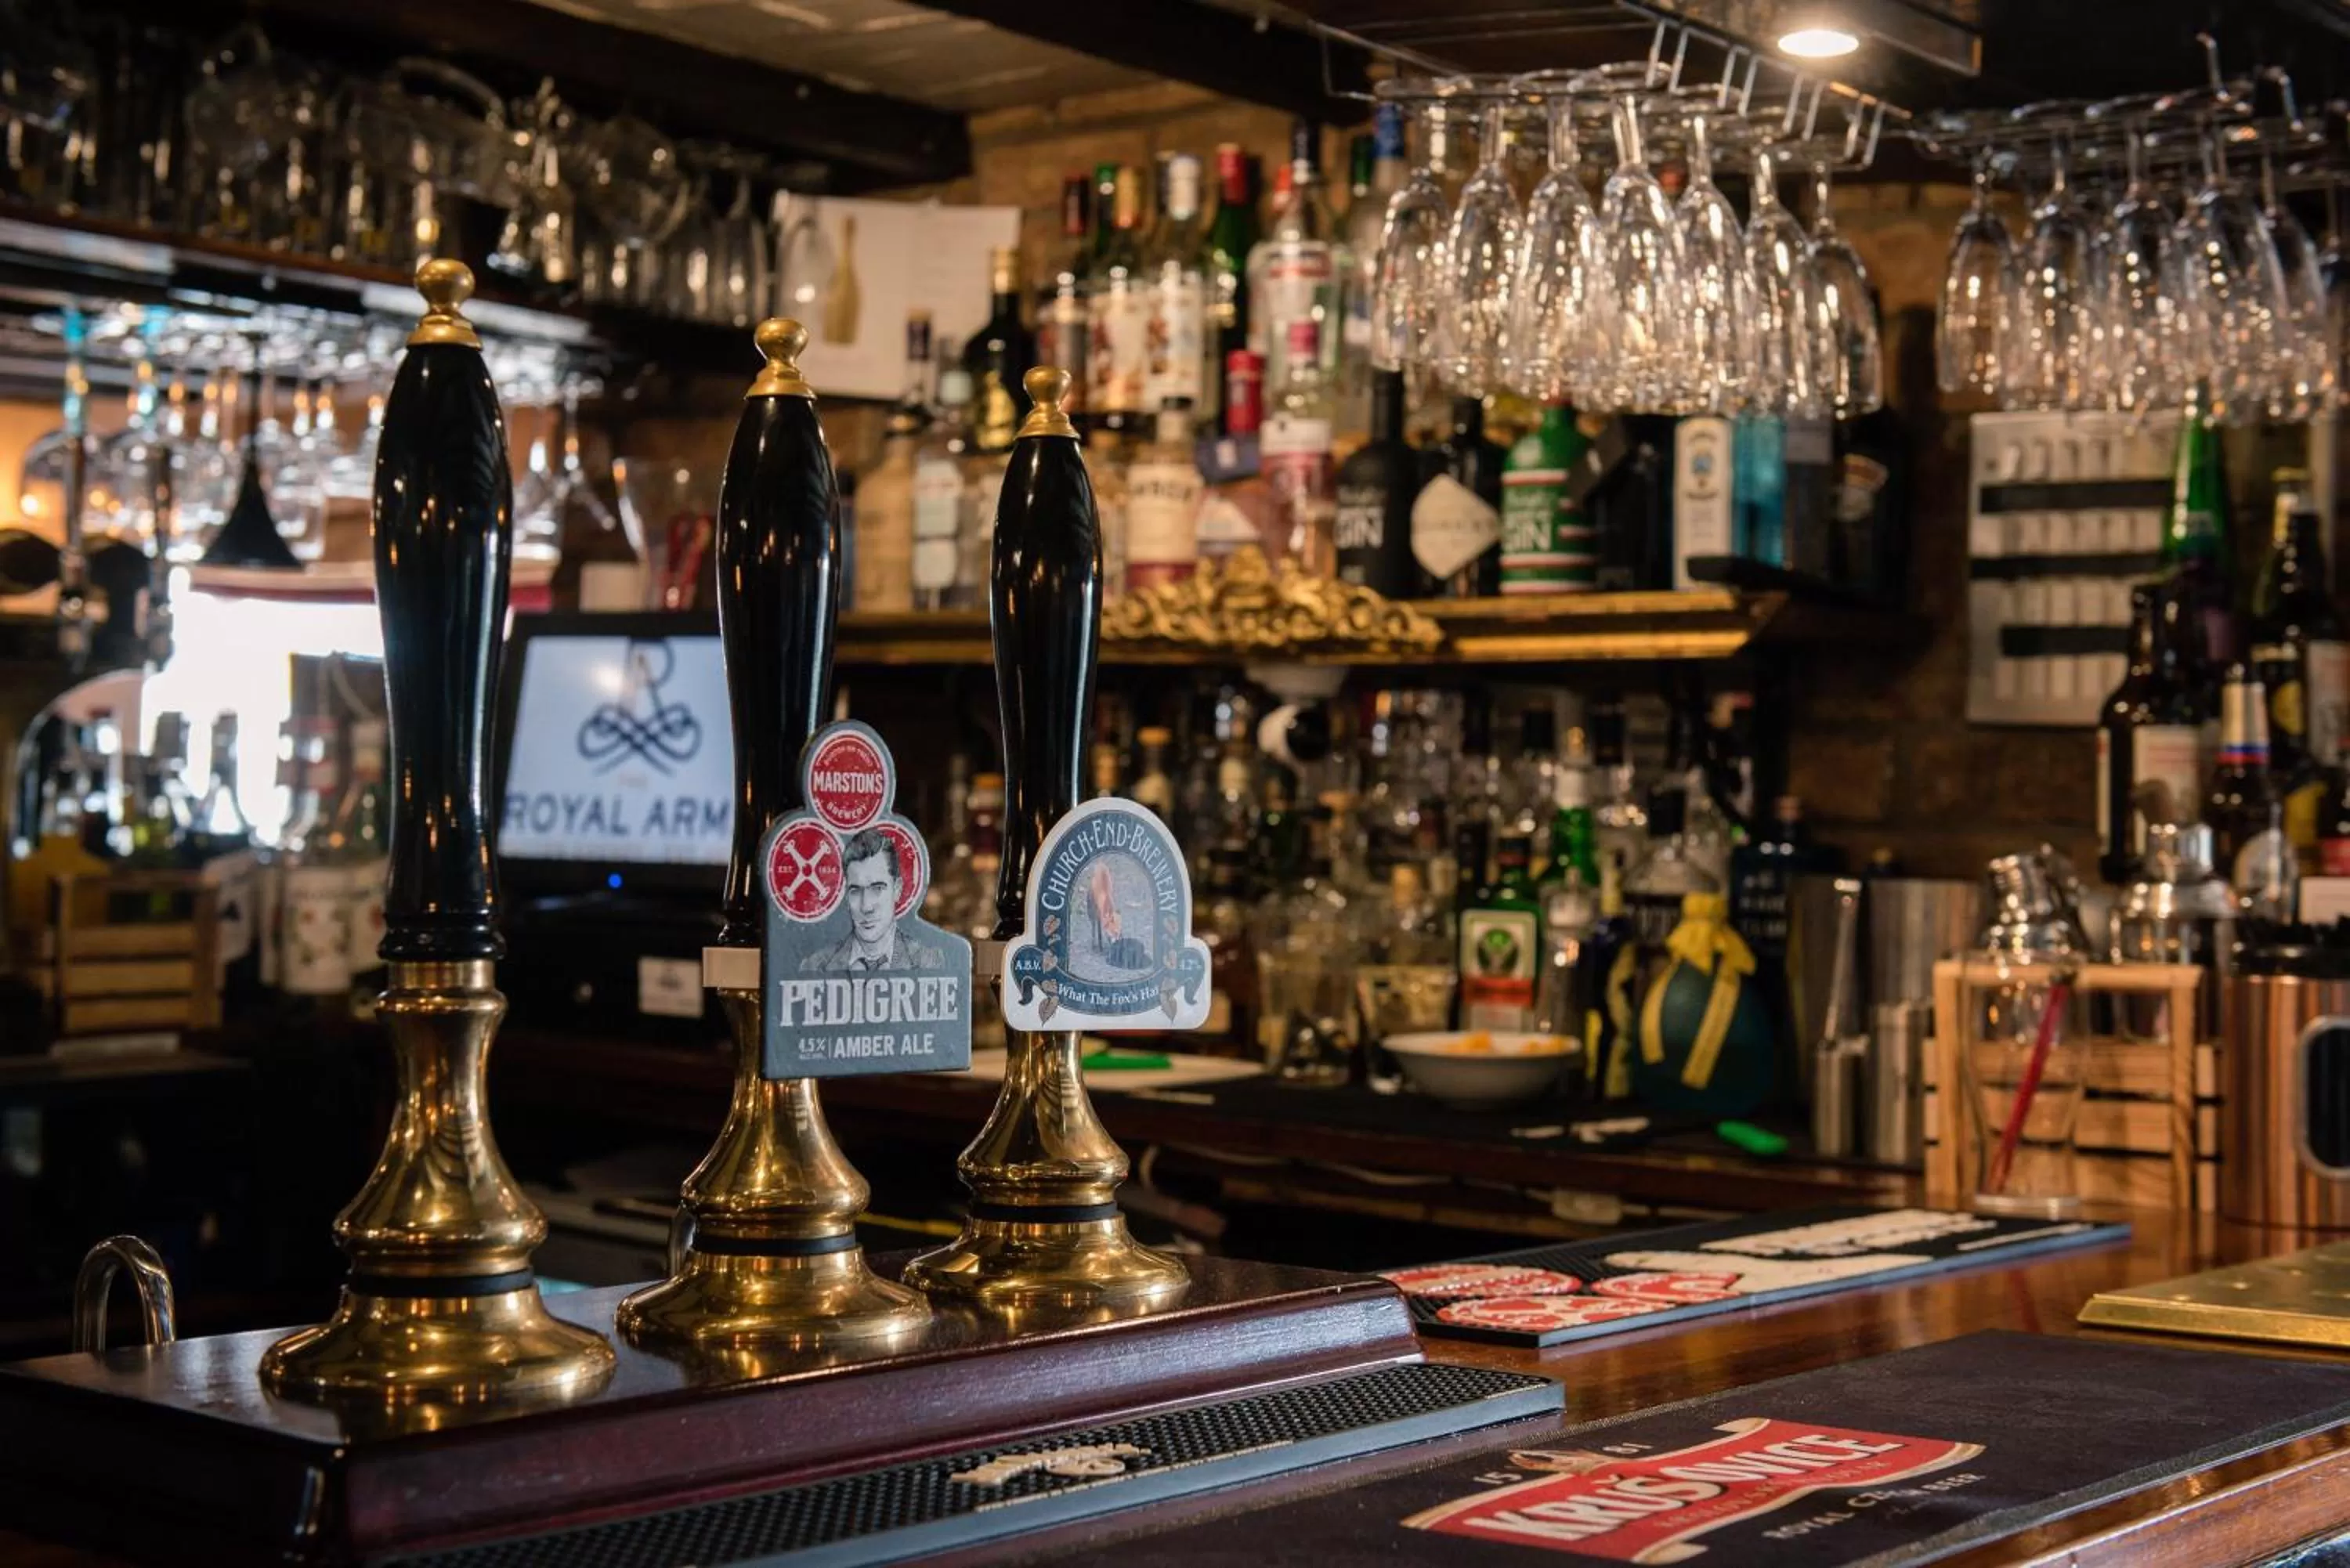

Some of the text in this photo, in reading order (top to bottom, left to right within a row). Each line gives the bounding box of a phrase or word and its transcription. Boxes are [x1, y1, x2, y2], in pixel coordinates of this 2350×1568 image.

[813, 770, 884, 794] MARSTON'S
[506, 791, 631, 836] ROYAL
[826, 801, 867, 820] BREWERY
[1041, 818, 1178, 913] CHURCH END BREWERY
[779, 977, 959, 1028] PEDIGREE
[1058, 983, 1086, 1003] What
[1089, 992, 1110, 1006] The
[833, 1035, 895, 1058] AMBER
[901, 1033, 935, 1055] ALE
[1463, 1434, 1905, 1541] KRUŠOVICE
[1473, 1471, 1524, 1486] 15
[1761, 1512, 1856, 1539] ROYAL
